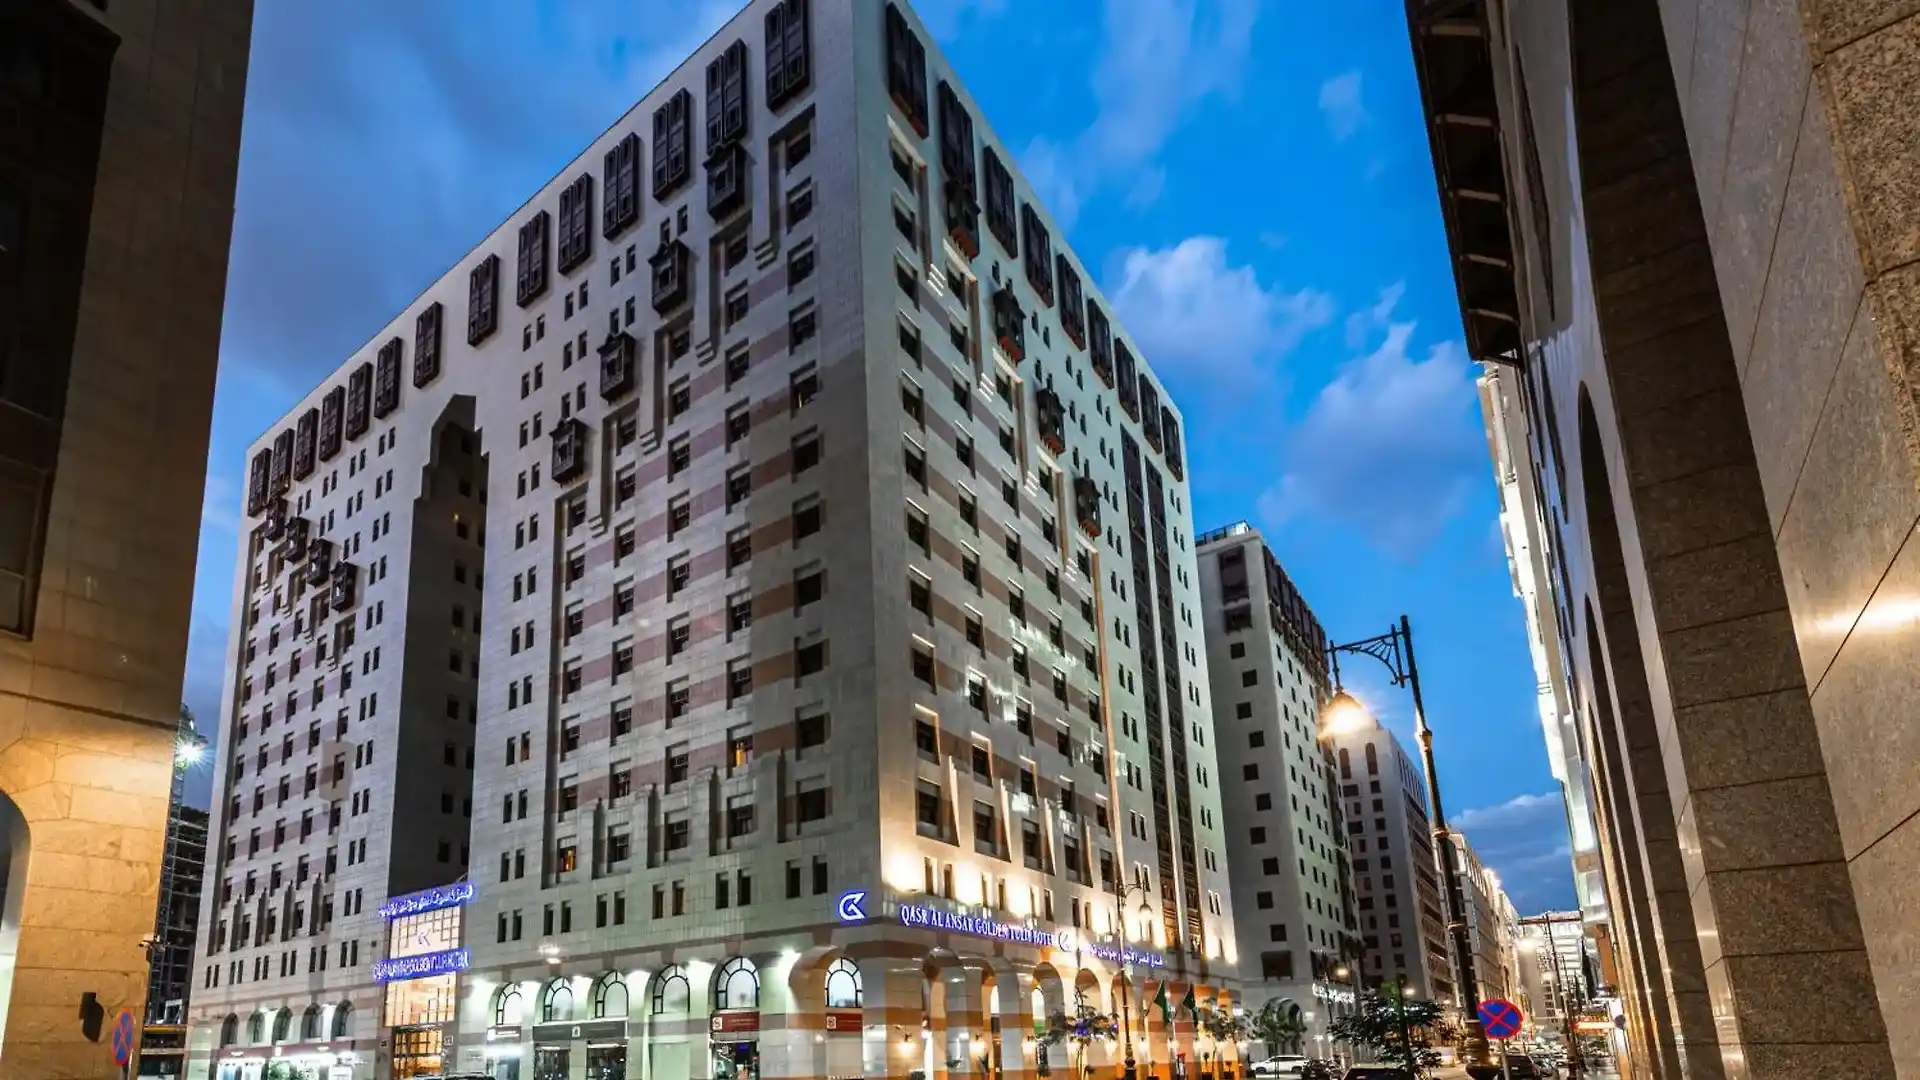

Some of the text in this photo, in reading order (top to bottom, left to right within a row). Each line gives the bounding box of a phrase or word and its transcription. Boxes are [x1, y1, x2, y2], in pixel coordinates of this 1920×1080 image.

[901, 905, 928, 926] QASR
[931, 908, 944, 927] AL
[945, 912, 974, 932] ANSAR
[976, 918, 1009, 939] GOLDEN
[1033, 930, 1055, 945] HOTE
